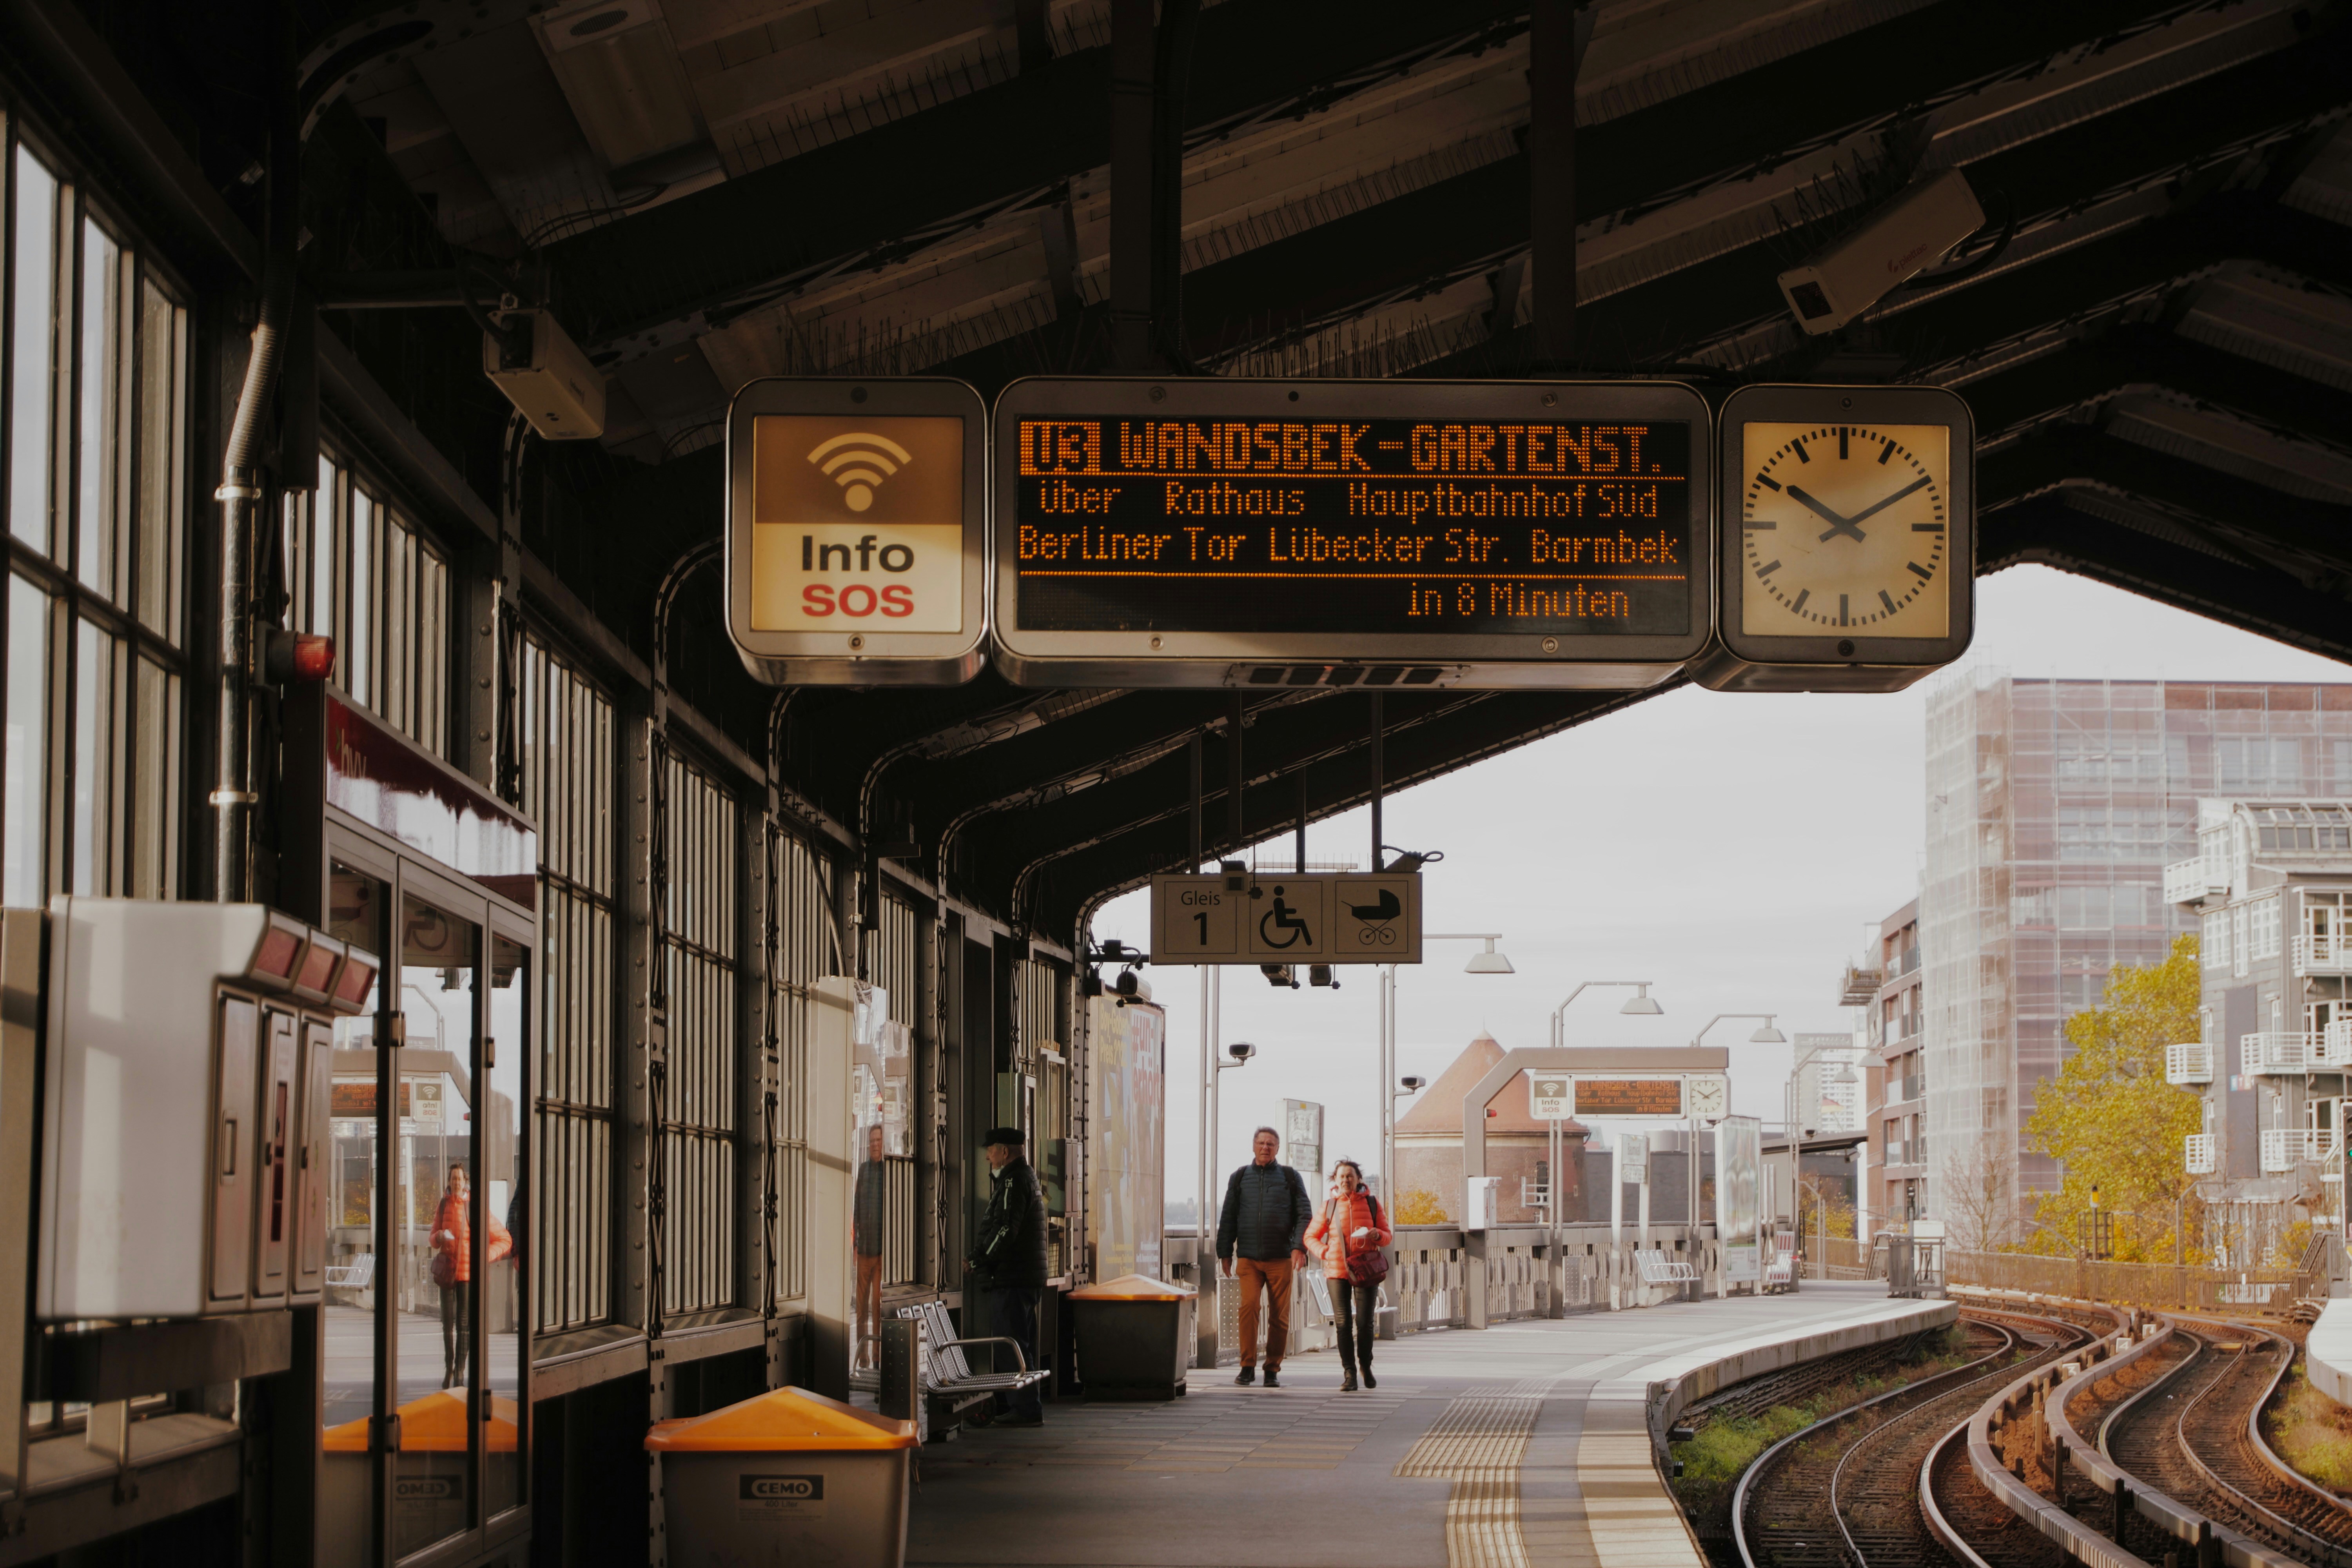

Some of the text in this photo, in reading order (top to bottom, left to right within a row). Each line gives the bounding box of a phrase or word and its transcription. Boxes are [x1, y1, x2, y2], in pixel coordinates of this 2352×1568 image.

[1898, 243, 1927, 270] plettac
[1024, 422, 1098, 474] U3
[1166, 481, 1305, 515] Rathaus
[1349, 482, 1587, 525] Hauptbahnhof
[1598, 484, 1657, 518] Süd
[802, 535, 914, 573] Info
[1019, 525, 1678, 564] Berliner Tor Lübecker Str. Barmbek
[801, 584, 915, 618] SOS
[1407, 582, 1629, 617] in 8 Minuten
[1181, 890, 1221, 906] Gleis
[1193, 911, 1207, 946] 1
[1100, 1035, 1113, 1065] Preis
[2119, 1341, 2129, 1350] 4
[2068, 1366, 2077, 1376] 3
[757, 1483, 809, 1494] CEMO
